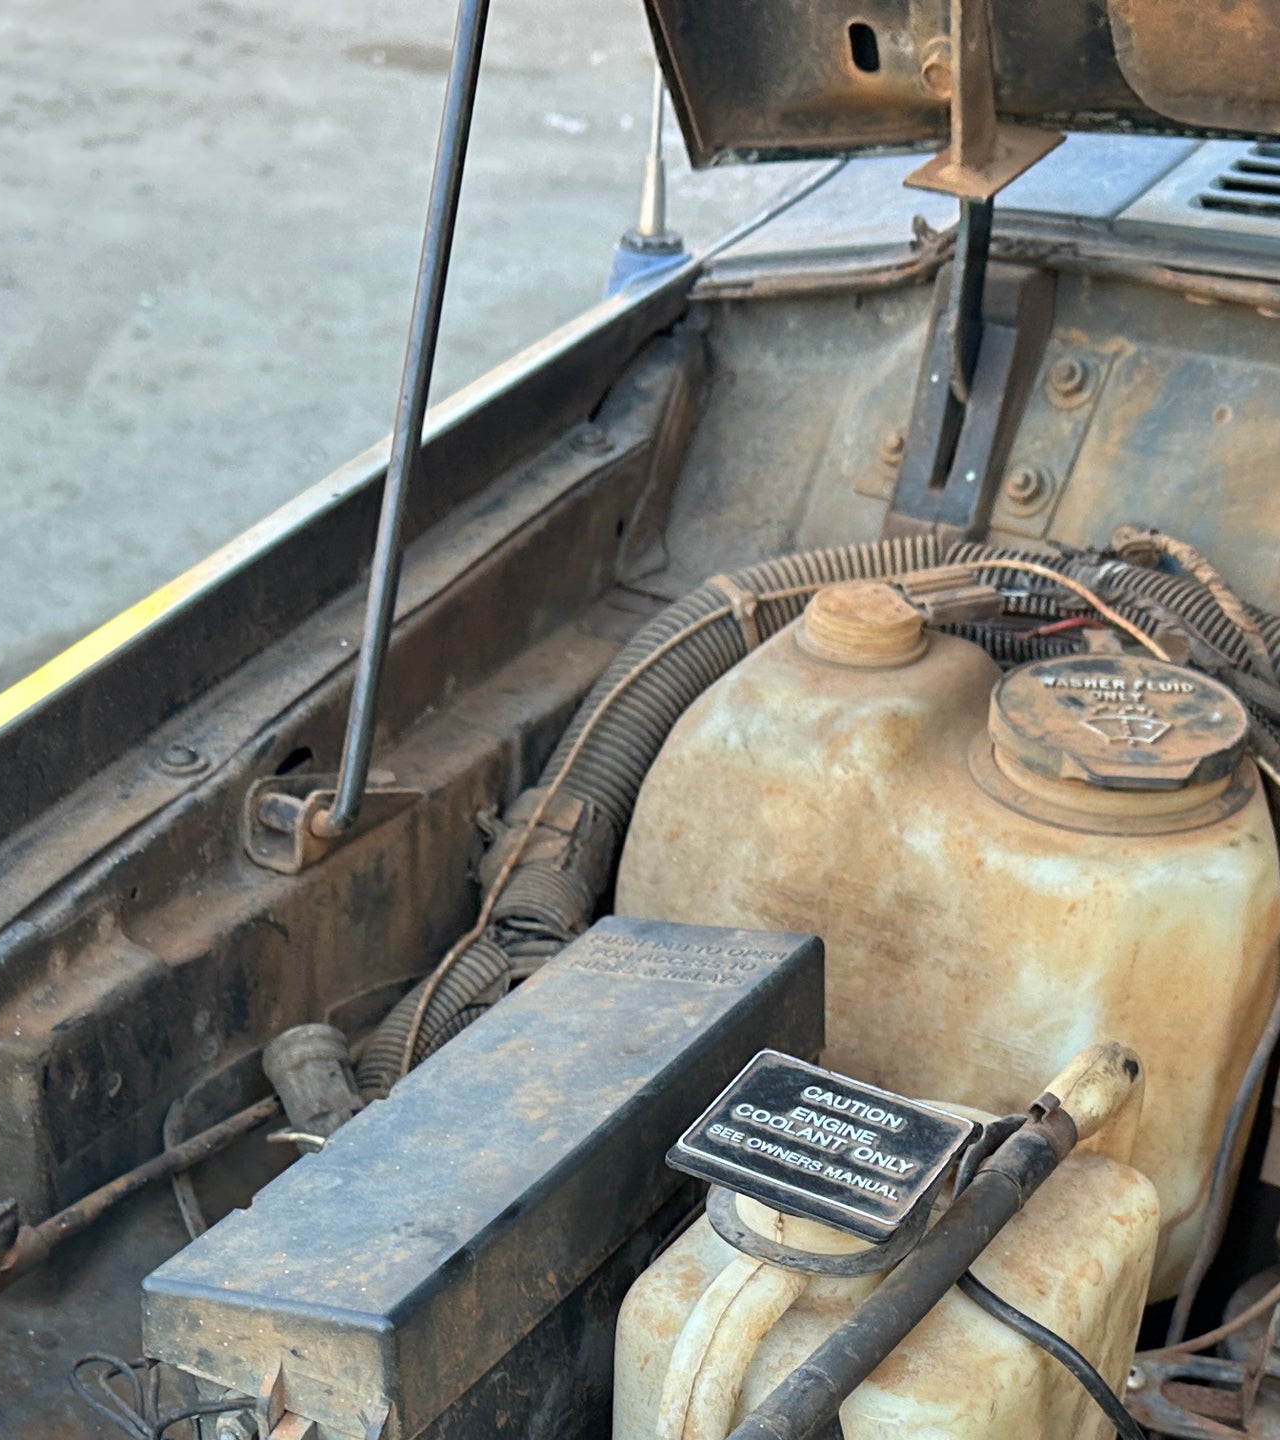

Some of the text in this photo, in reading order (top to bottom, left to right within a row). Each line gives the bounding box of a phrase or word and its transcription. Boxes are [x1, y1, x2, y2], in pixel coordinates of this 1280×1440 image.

[1133, 680, 1195, 693] FLUID
[790, 1106, 877, 1145] ENGINE
[803, 1085, 903, 1129] CAUTION
[735, 1103, 913, 1174] COOLANT ONLY
[709, 1123, 899, 1201] SEE OWNERS MANUAL
